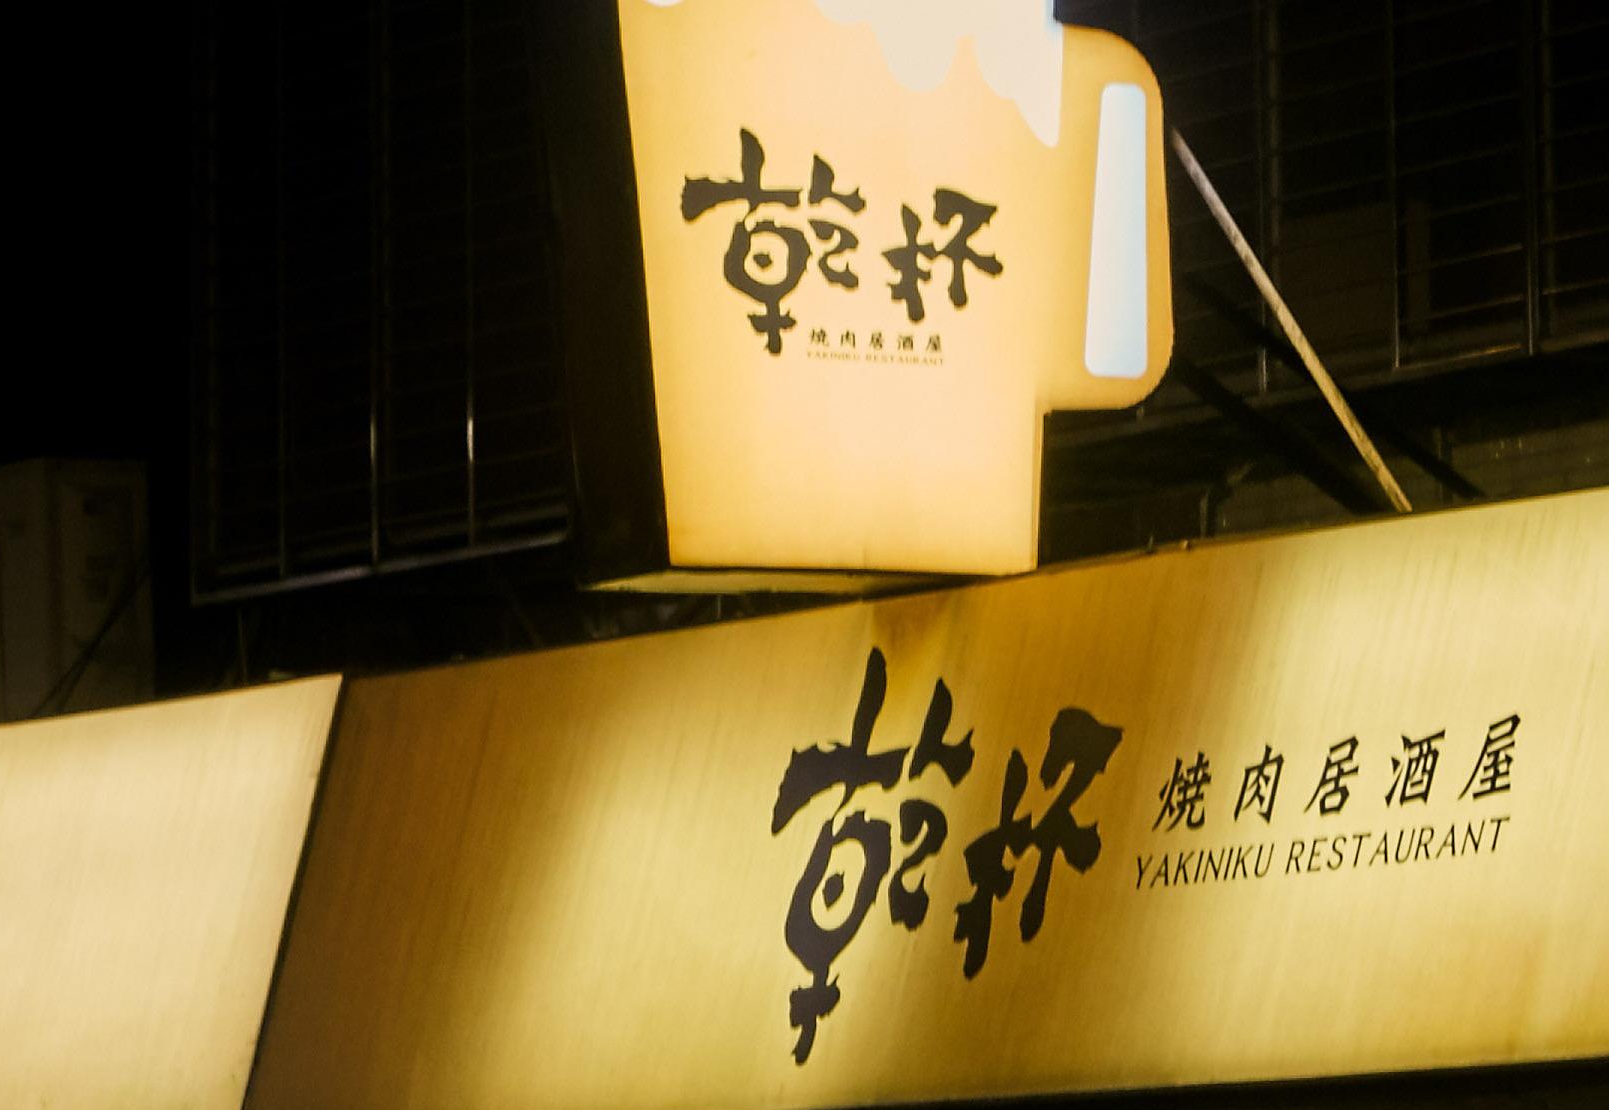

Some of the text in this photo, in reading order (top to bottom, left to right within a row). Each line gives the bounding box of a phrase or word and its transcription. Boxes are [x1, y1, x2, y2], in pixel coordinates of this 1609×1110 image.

[681, 128, 1004, 355] 乾杯
[771, 647, 1125, 1066] 乾杯
[1135, 815, 1511, 891] YAKINIKU RESTAURANT
